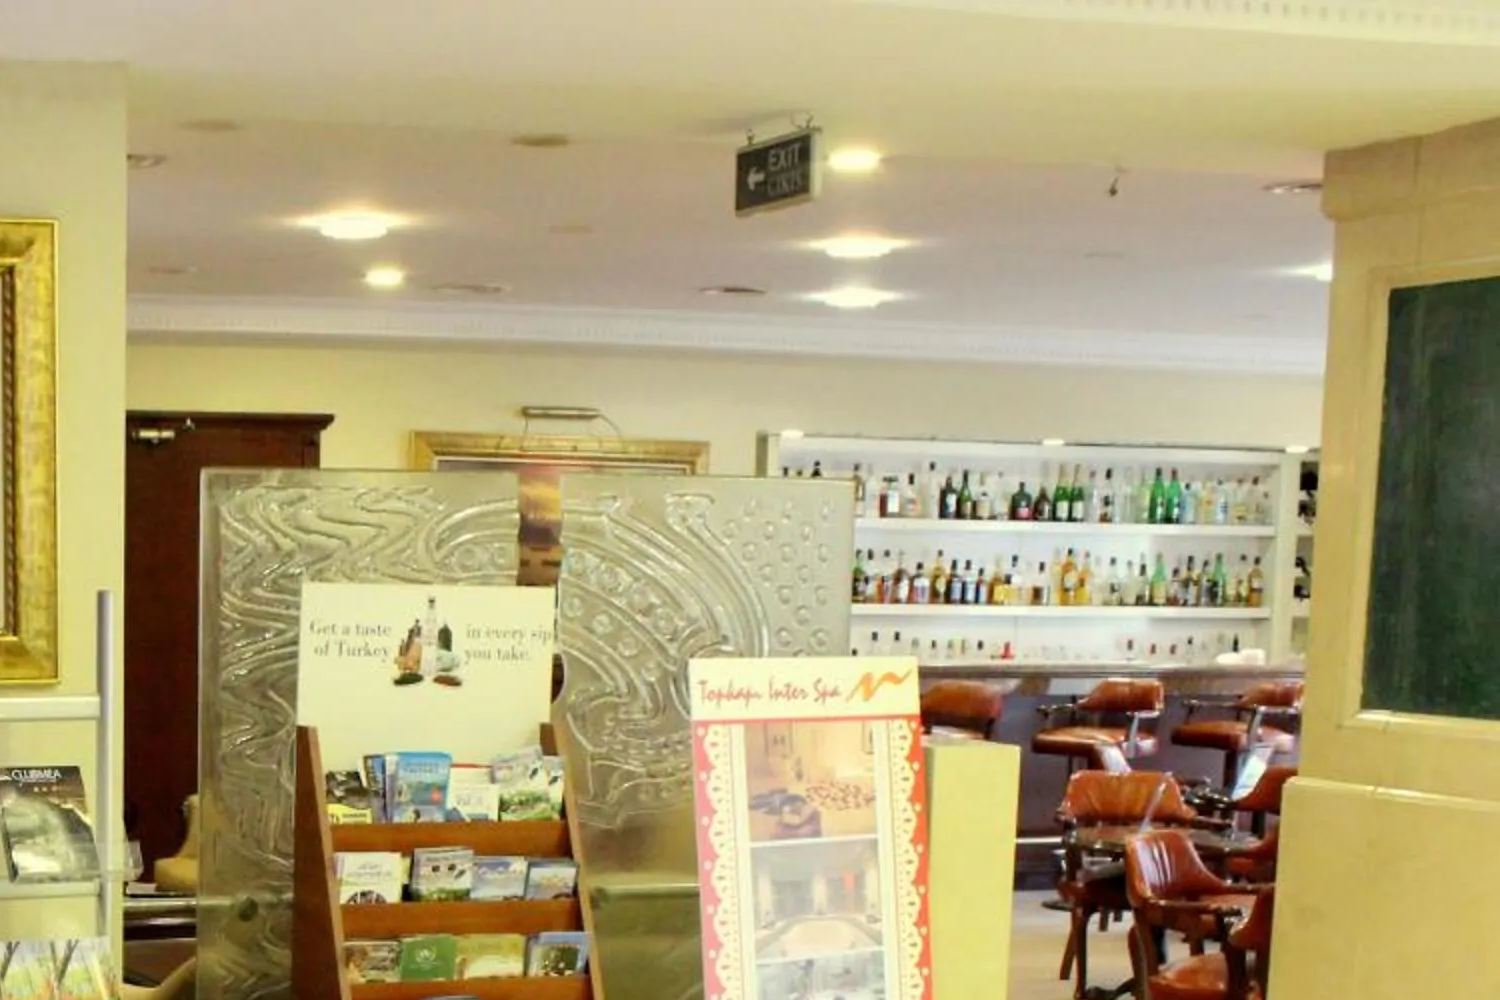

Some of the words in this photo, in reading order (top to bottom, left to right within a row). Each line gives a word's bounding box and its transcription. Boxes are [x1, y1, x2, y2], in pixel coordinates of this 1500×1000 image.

[768, 142, 801, 172] EXIT
[309, 618, 337, 636] Get
[341, 624, 351, 636] a
[355, 622, 392, 637] taste
[466, 624, 481, 639] in
[485, 628, 524, 646] every
[313, 639, 331, 657] of
[334, 639, 389, 664] Turkey
[463, 648, 491, 665] you
[812, 676, 842, 707] Spa
